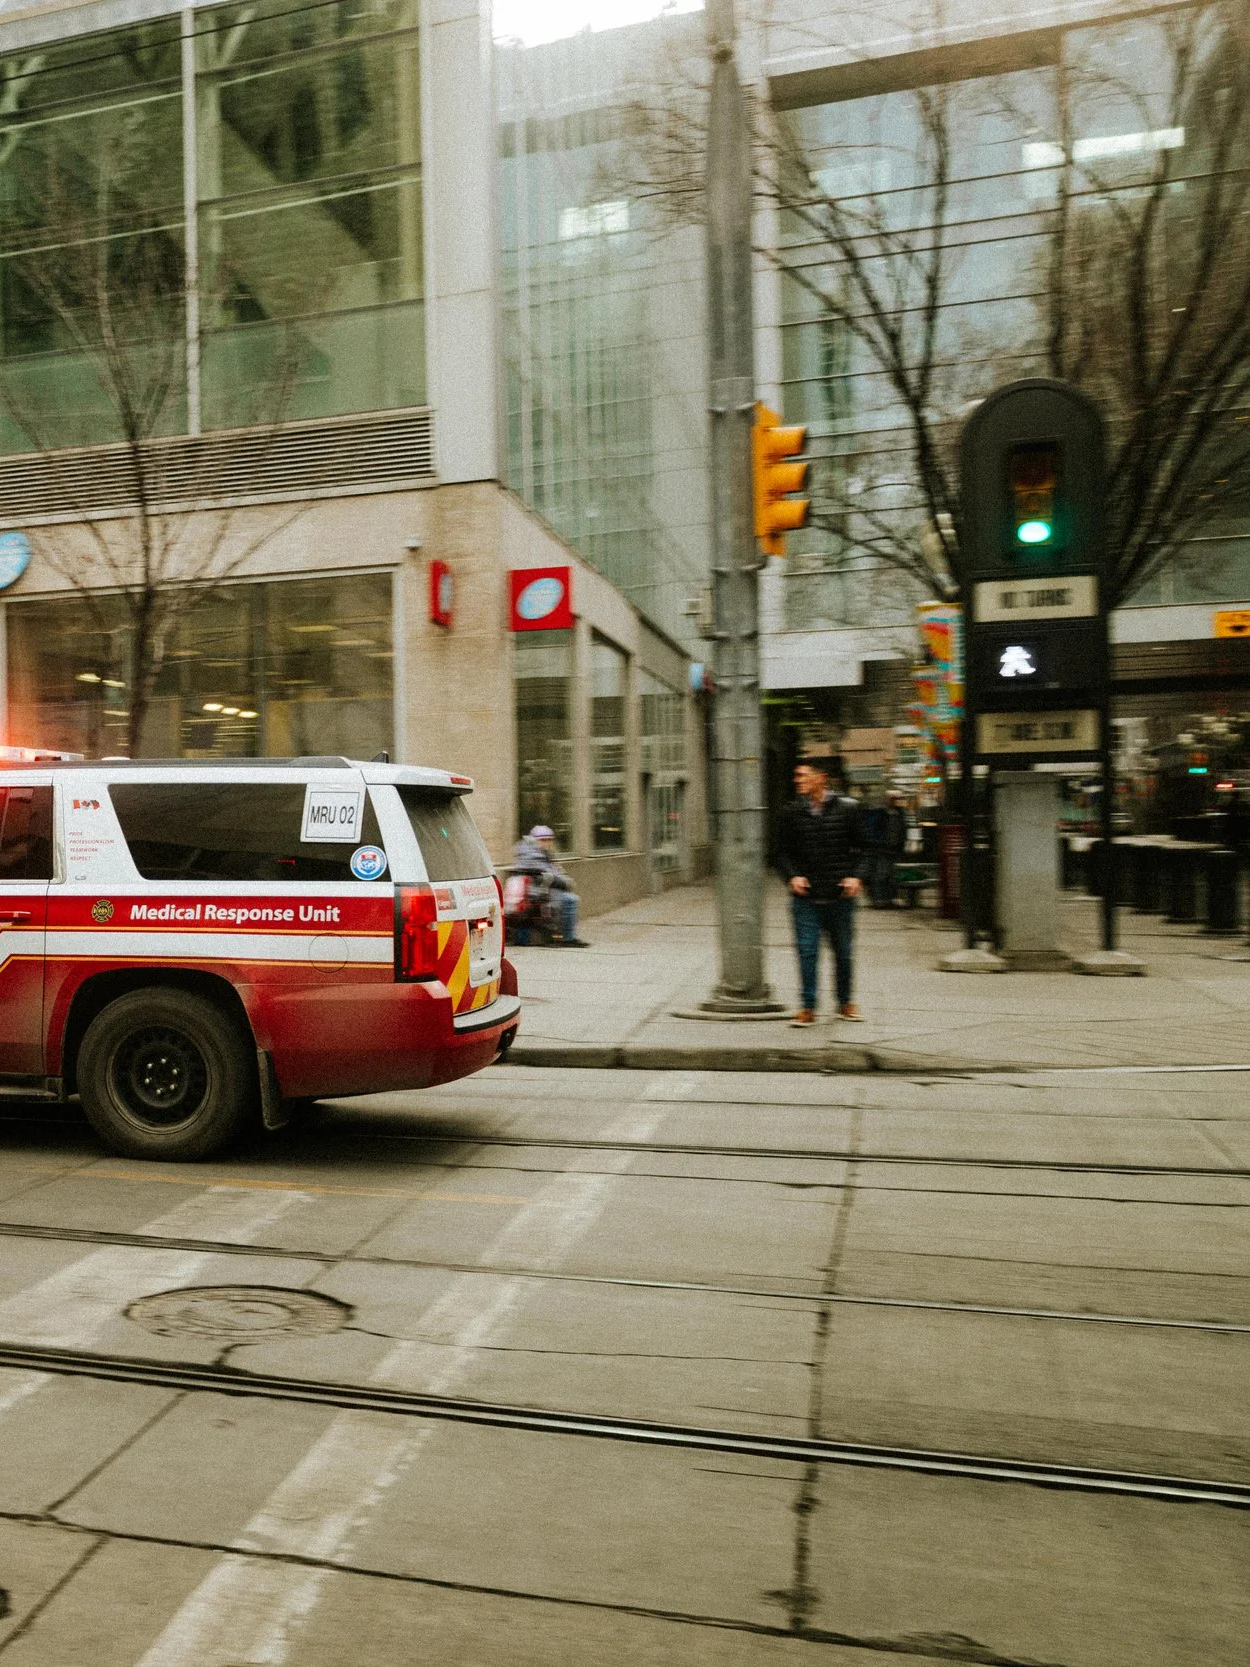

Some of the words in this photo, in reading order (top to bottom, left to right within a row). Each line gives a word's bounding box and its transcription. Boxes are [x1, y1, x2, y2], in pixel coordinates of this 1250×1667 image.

[310, 805, 337, 824] MRU
[339, 805, 355, 824] 02
[130, 904, 200, 920] Medical
[204, 904, 294, 924] Response
[298, 905, 341, 922] Unit
